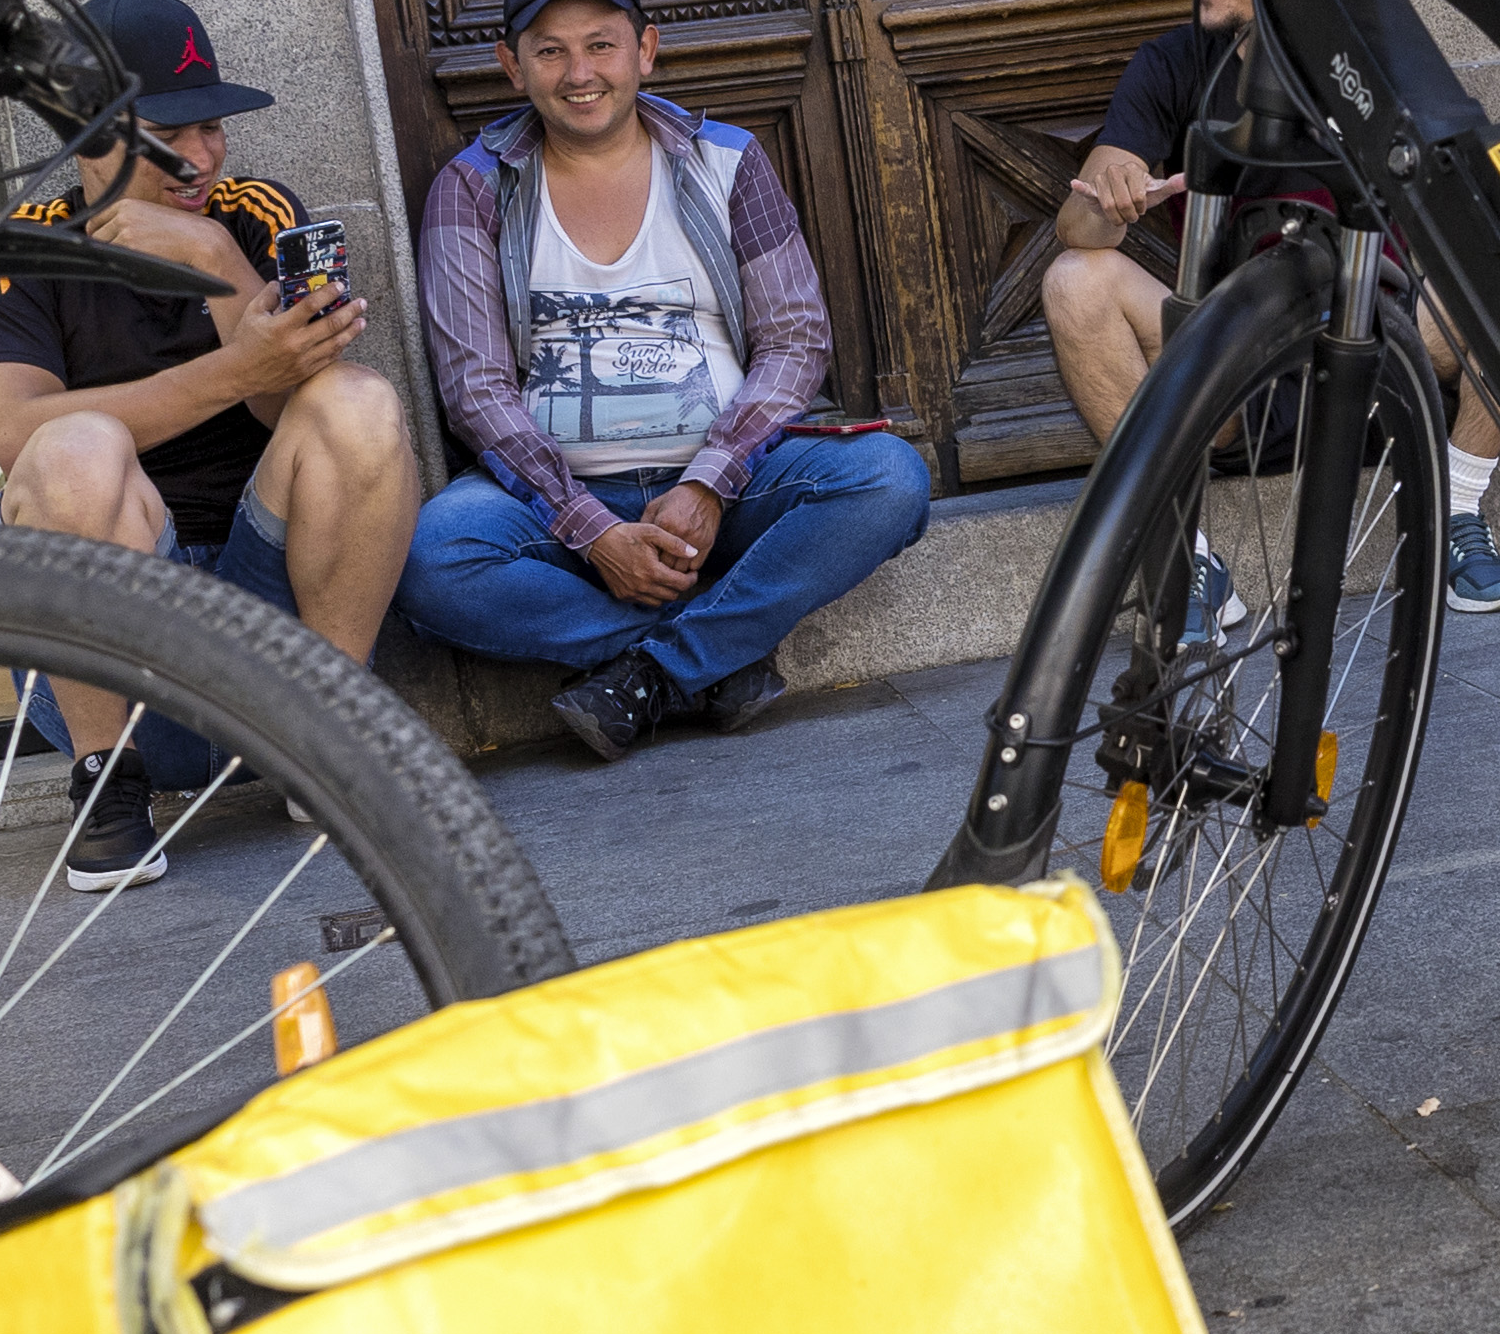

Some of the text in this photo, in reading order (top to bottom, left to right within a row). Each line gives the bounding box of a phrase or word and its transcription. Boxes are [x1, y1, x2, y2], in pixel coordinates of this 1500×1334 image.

[1330, 52, 1374, 121] NCM
[305, 230, 325, 242] HIS
[310, 258, 334, 271] EAM
